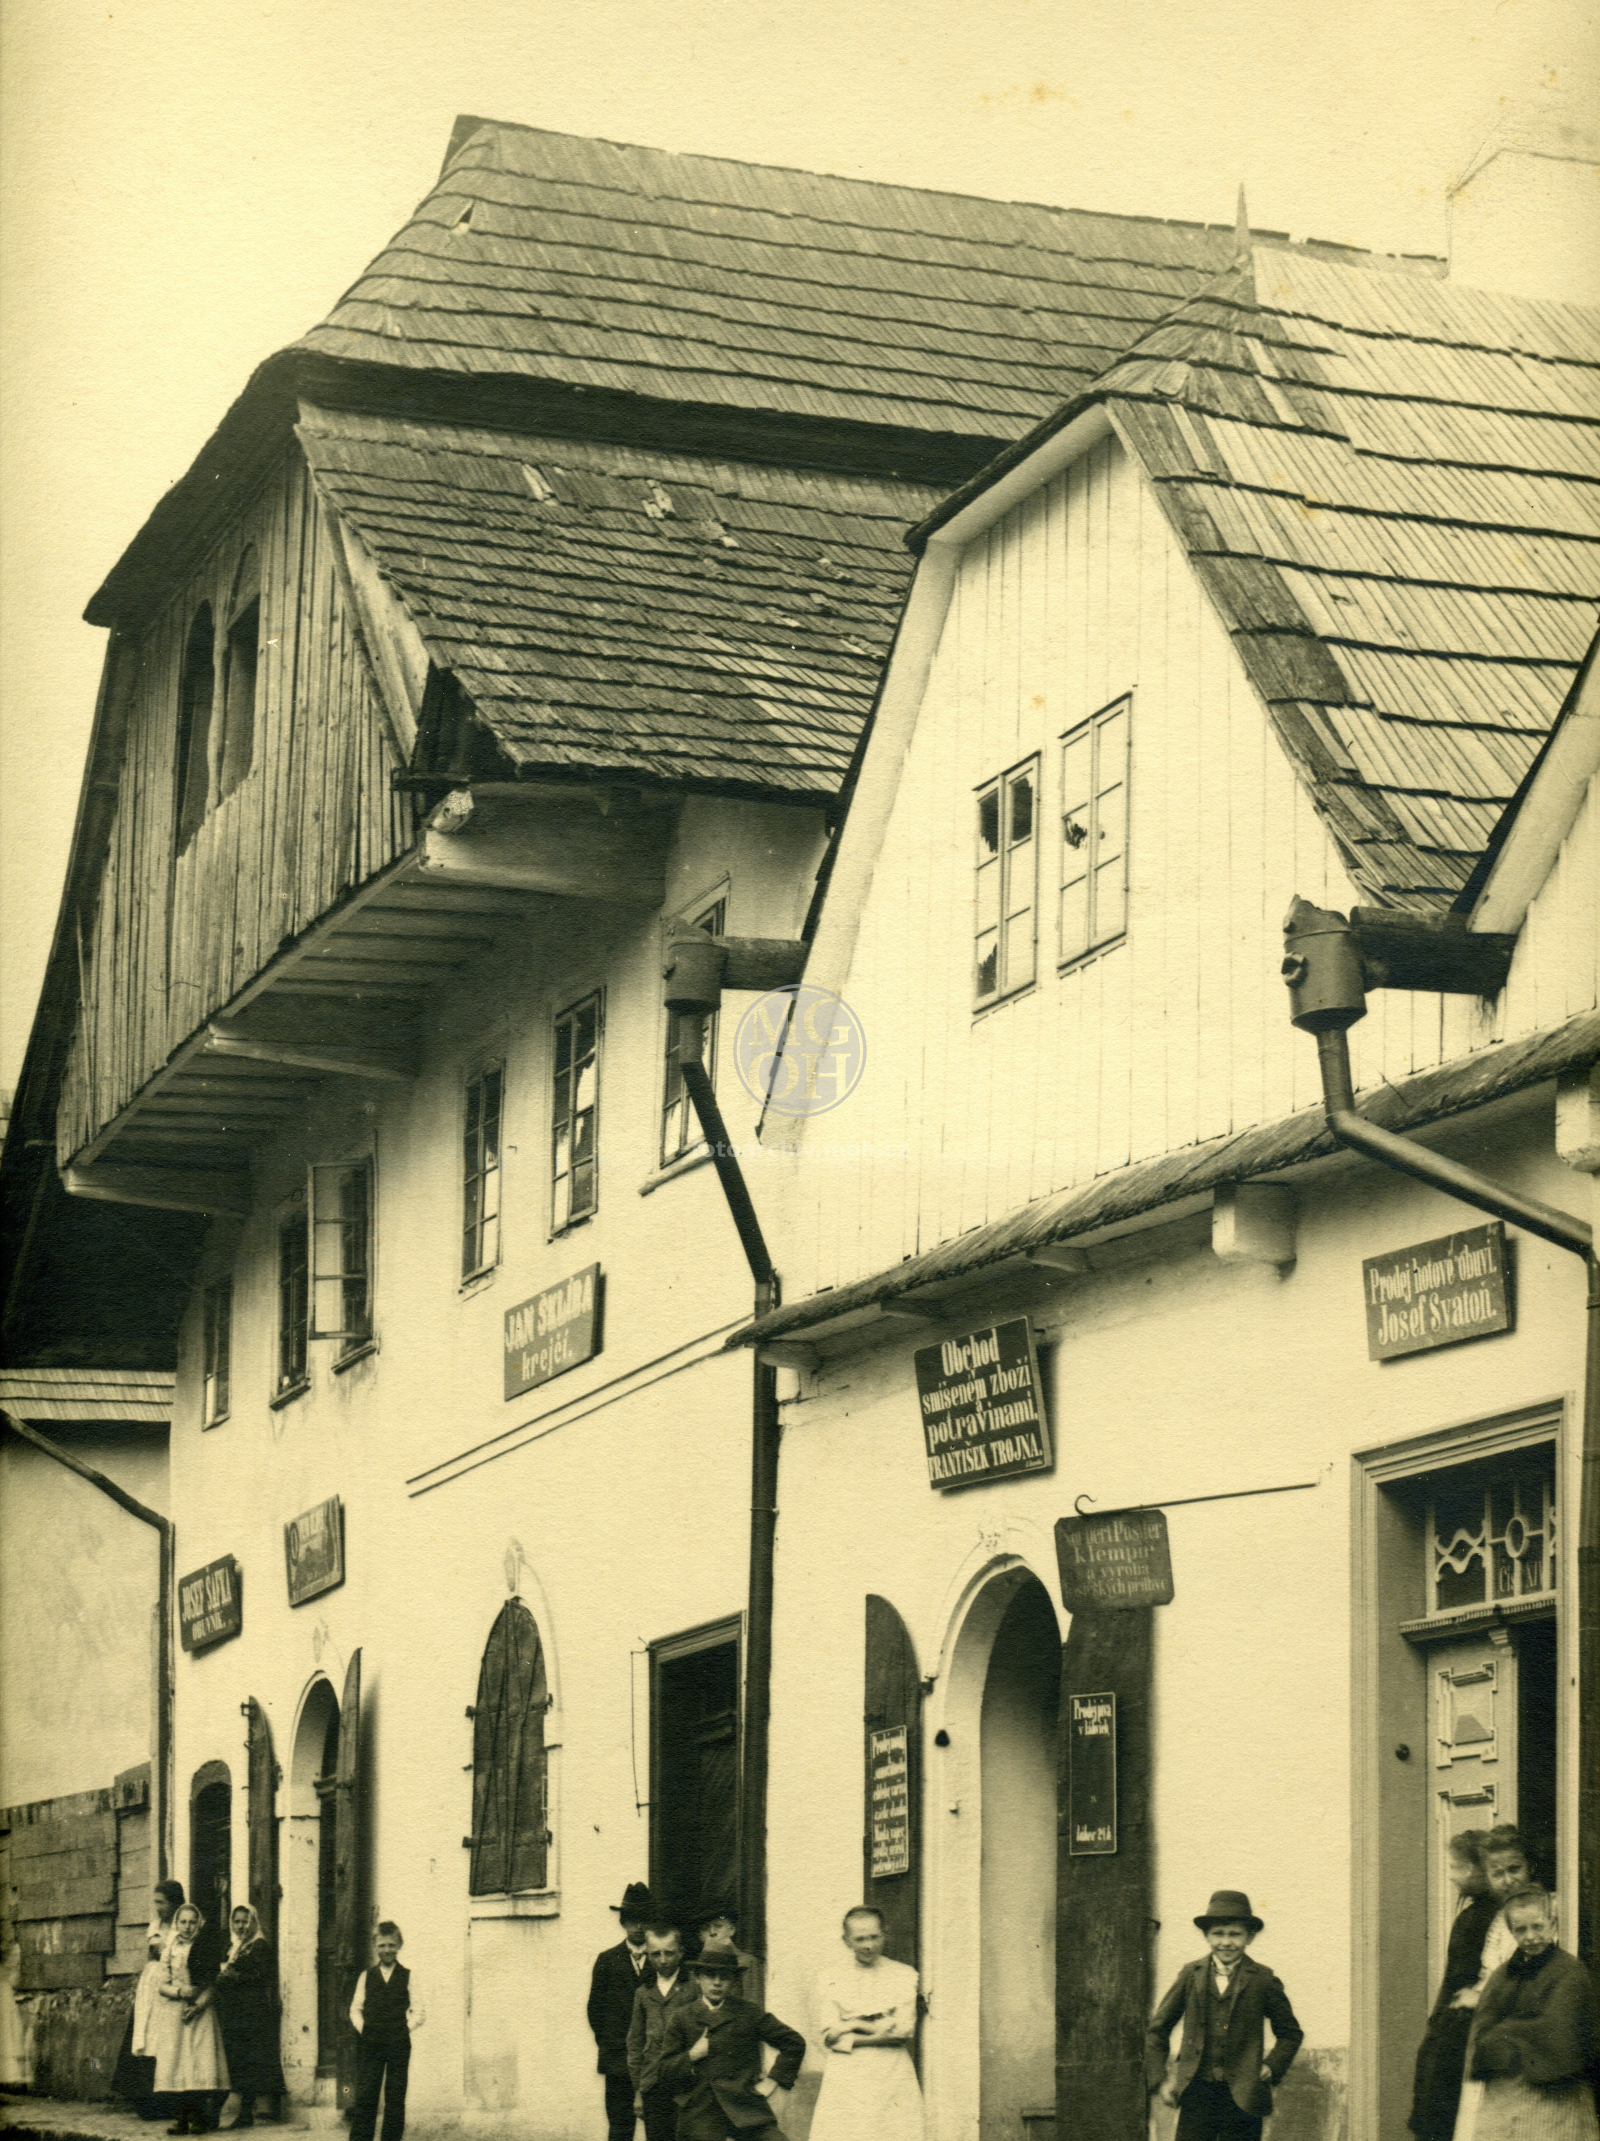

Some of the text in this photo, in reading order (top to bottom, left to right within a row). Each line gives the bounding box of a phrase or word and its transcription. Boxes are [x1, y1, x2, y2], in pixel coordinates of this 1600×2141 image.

[1369, 1262, 1412, 1305] Prodej
[504, 1304, 535, 1354] JAN
[1378, 1293, 1427, 1346] Josef
[522, 1328, 573, 1381] krejčí.
[941, 1327, 1000, 1377] Obchod
[990, 1355, 1033, 1396] zboží
[927, 1390, 1039, 1454] potravinami.
[975, 1399, 984, 1413] a
[927, 1440, 990, 1481] FRANTIŠEK
[181, 1577, 205, 1623] JOSEF
[1073, 1698, 1097, 1724] Prodej
